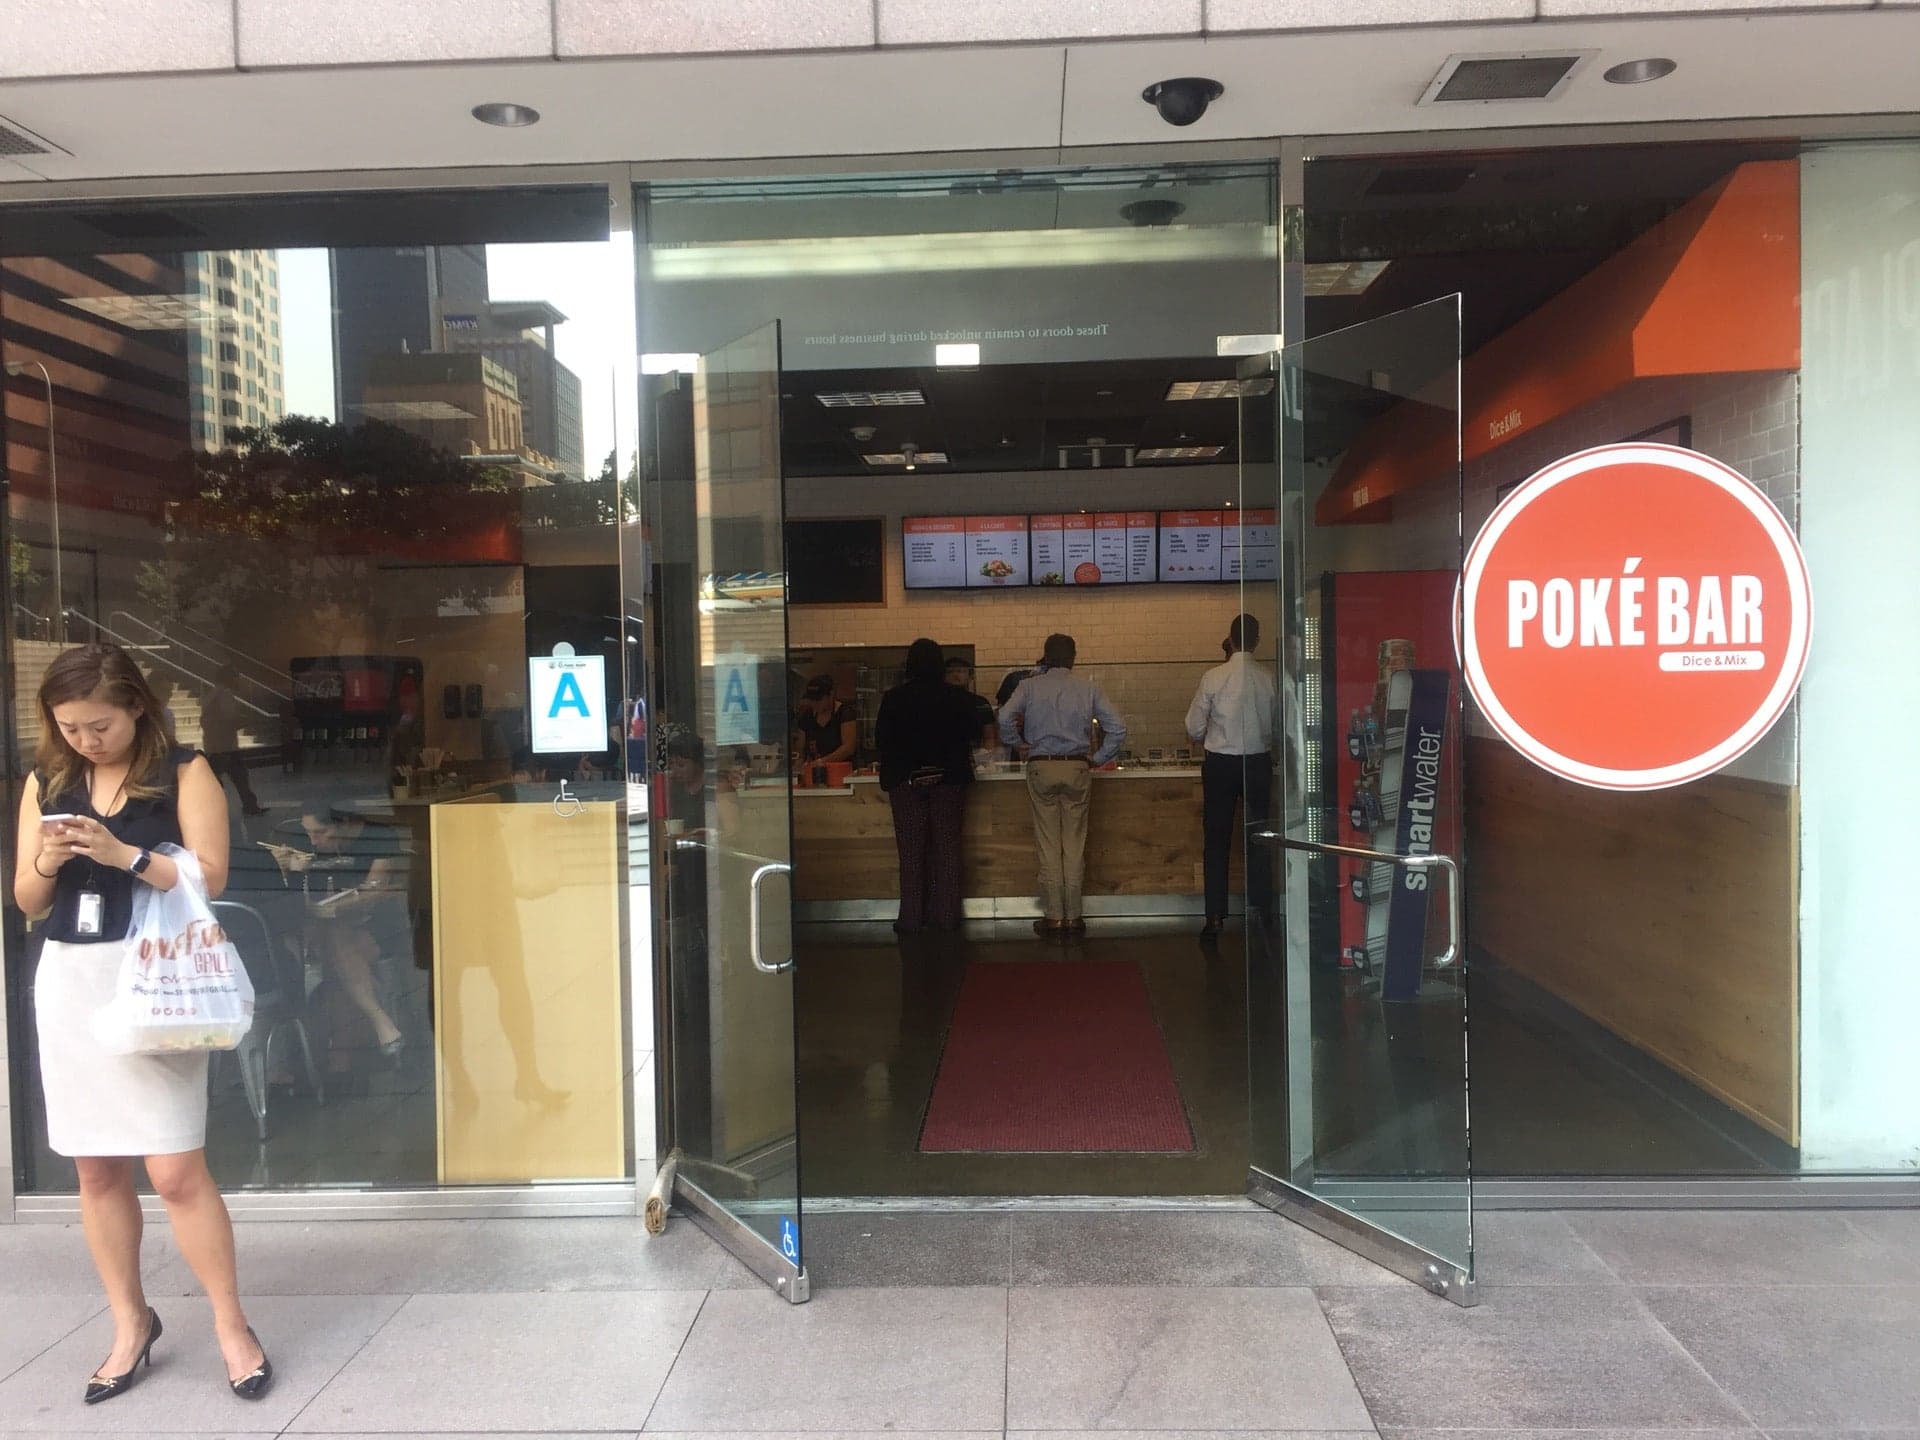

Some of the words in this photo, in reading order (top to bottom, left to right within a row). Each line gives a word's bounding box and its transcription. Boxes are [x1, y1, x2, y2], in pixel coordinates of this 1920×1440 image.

[1508, 557, 1646, 649] POKÉ
[1657, 575, 1763, 646] BAR
[548, 672, 591, 718] A
